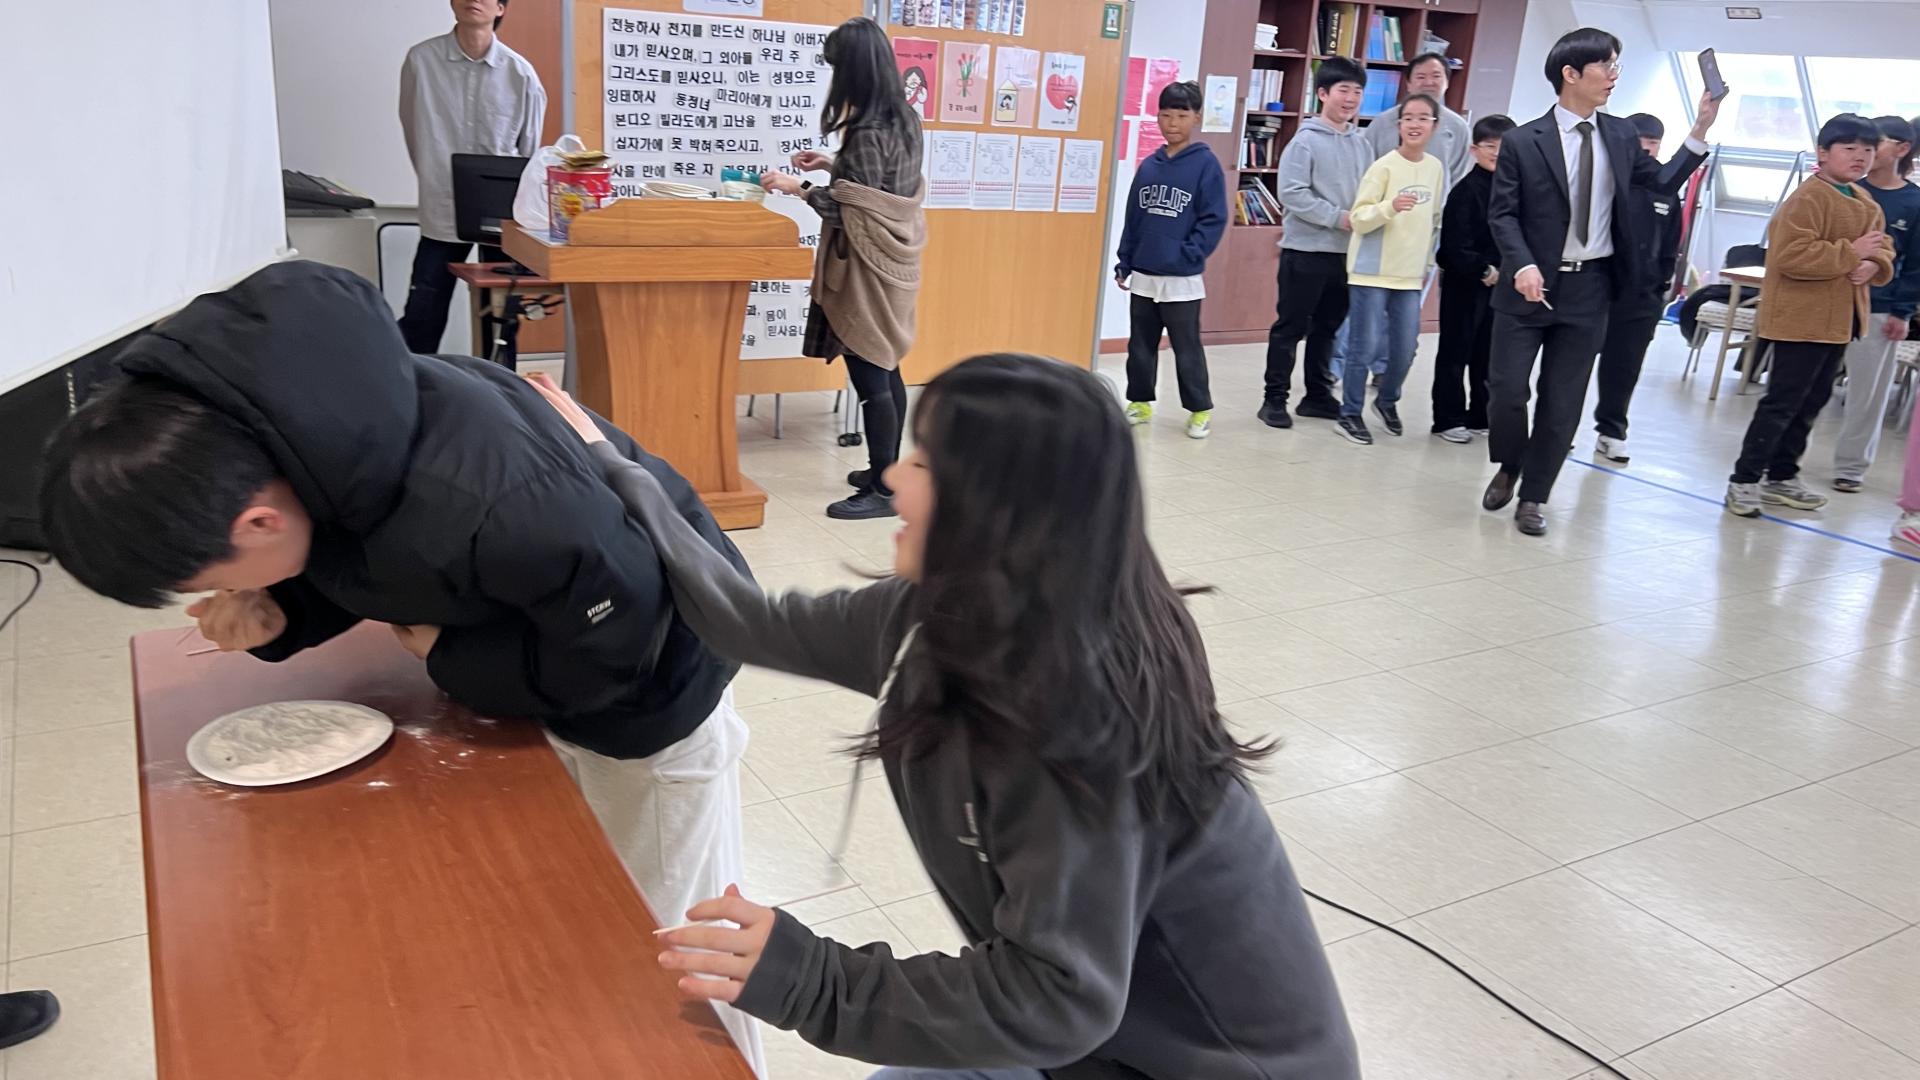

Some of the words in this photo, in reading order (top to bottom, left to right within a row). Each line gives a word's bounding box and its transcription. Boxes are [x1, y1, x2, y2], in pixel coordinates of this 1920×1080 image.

[610, 18, 660, 36] 전능하사
[711, 24, 744, 38] 만드신
[752, 29, 786, 43] 하나님
[614, 44, 639, 58] 내가
[702, 51, 712, 64] 그
[719, 51, 752, 65] 외아들
[760, 48, 783, 62] 우리
[789, 50, 800, 62] 주
[611, 65, 671, 84] 그리스도를
[738, 70, 760, 83] 이는
[772, 71, 816, 84] 성령으로
[607, 89, 656, 103] 잉태하사
[676, 92, 710, 111] 동정녀
[717, 88, 772, 108] 마리아에게
[616, 113, 651, 127] 본디오
[660, 113, 717, 128] 빌라도에게
[723, 114, 755, 128] 고난을
[616, 137, 663, 151] 십자가에
[671, 137, 682, 150] 못
[780, 138, 812, 153] 장사한
[642, 165, 666, 178] 만에
[673, 162, 696, 175] 죽은
[702, 163, 714, 176] 자
[1139, 184, 1192, 213] CALIF
